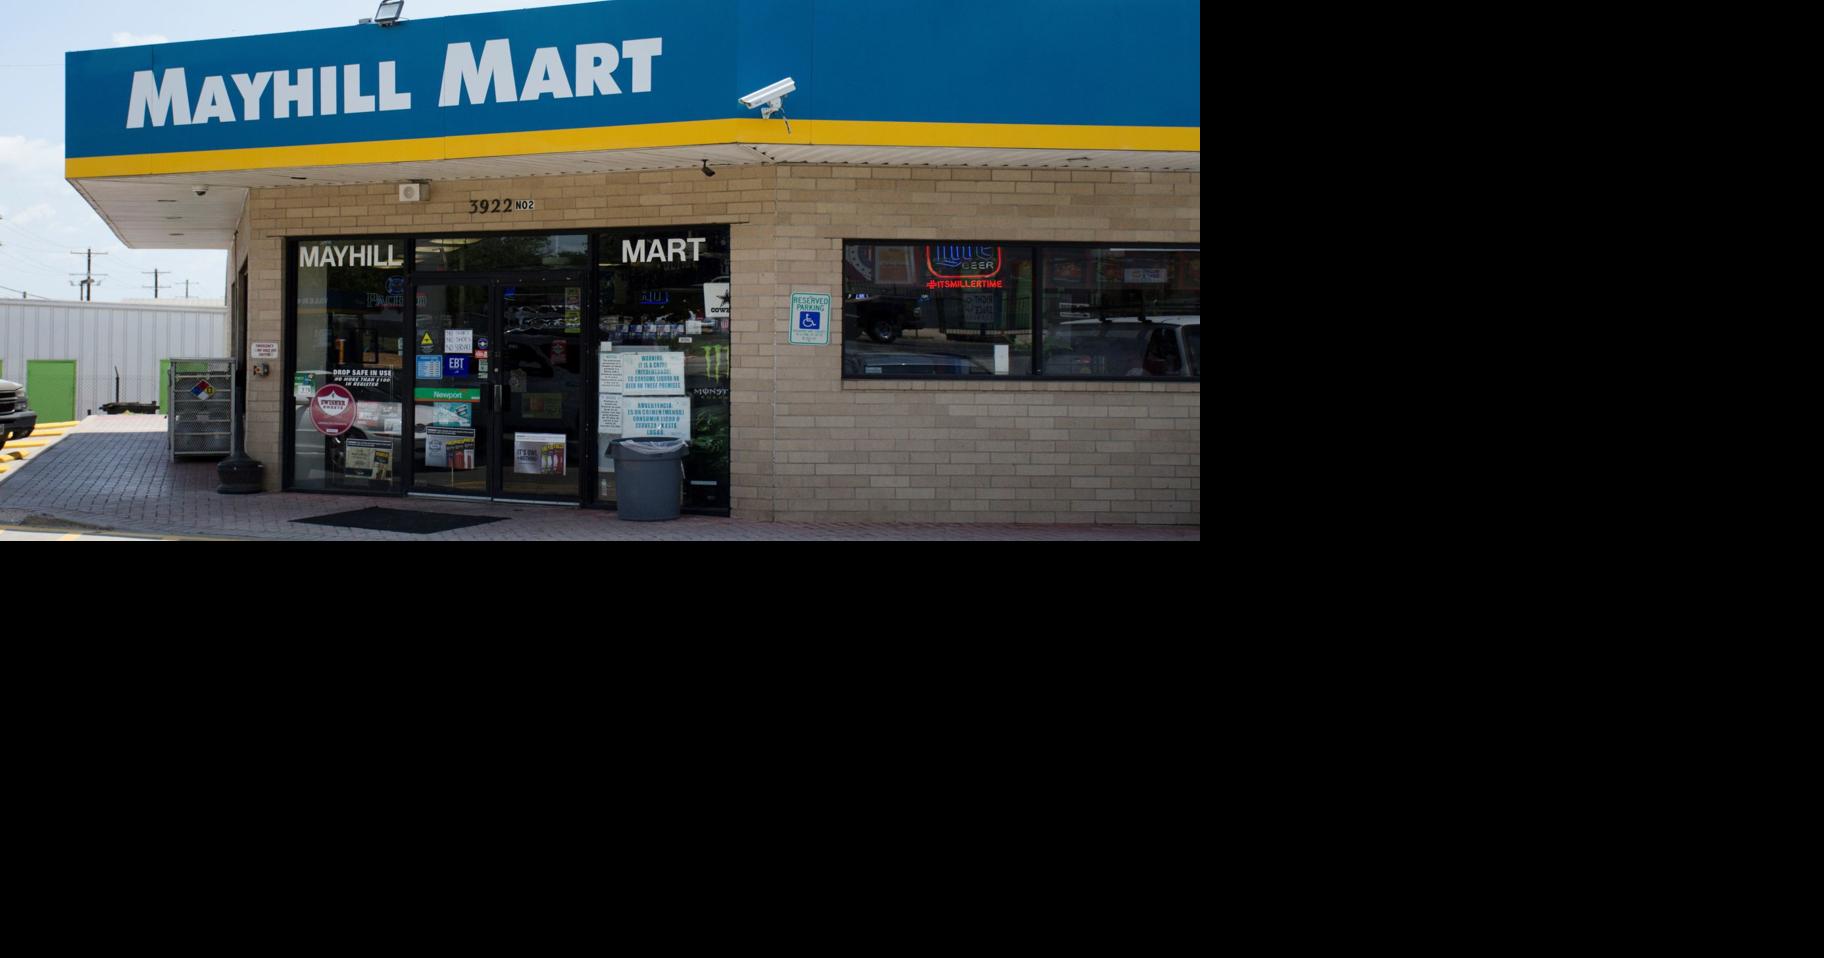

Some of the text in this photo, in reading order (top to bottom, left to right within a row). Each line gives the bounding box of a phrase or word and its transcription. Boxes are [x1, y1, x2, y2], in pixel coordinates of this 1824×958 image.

[126, 37, 662, 129] MAYHILL MART
[469, 199, 513, 214] 3922
[622, 237, 706, 263] MART
[299, 244, 404, 268] MAYHILL
[961, 262, 994, 270] BEER
[926, 279, 1003, 289] #ITSMILLERTIME
[793, 296, 829, 304] RESERVED
[797, 304, 824, 312] PARKING
[449, 357, 465, 368] EBT
[433, 391, 463, 399] Newport
